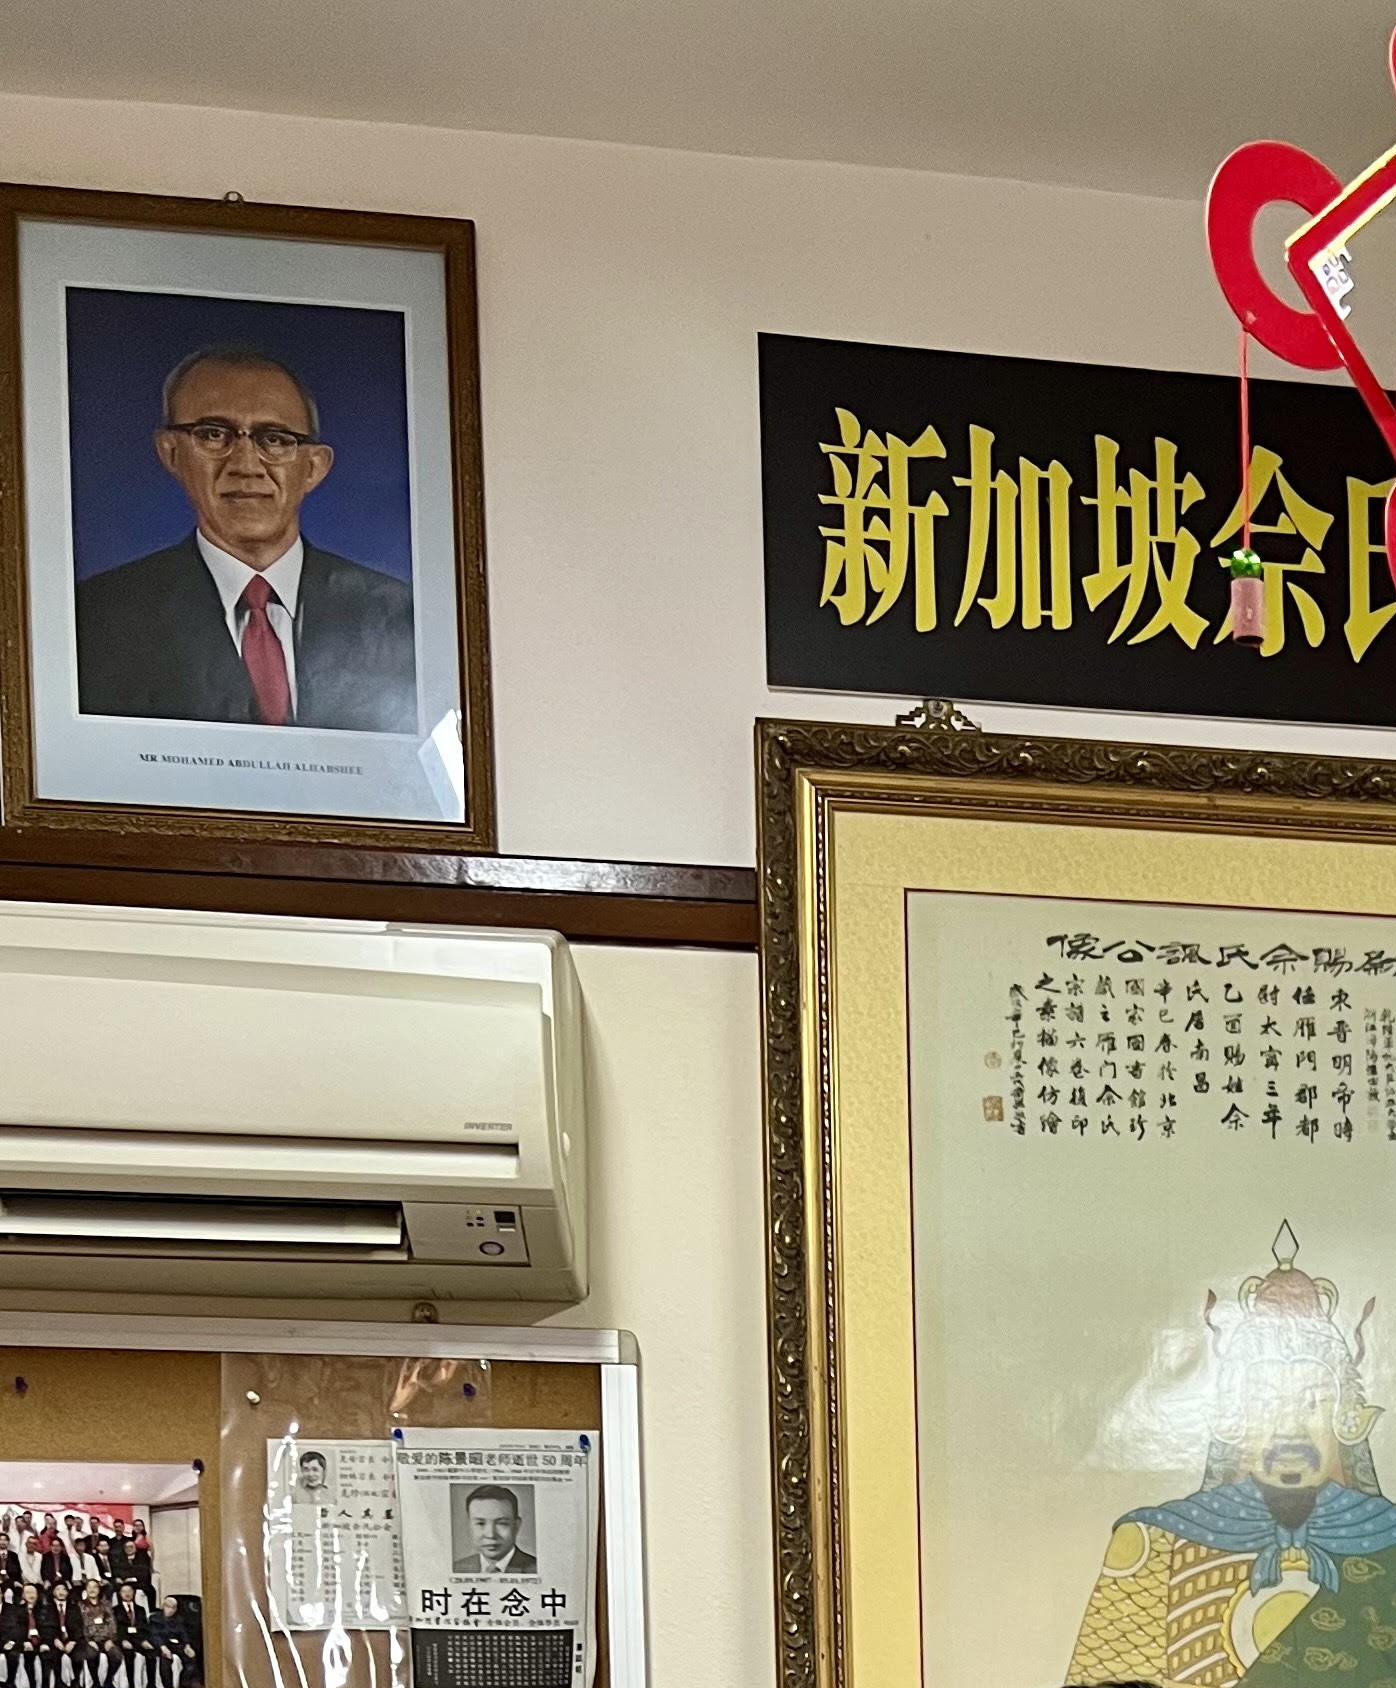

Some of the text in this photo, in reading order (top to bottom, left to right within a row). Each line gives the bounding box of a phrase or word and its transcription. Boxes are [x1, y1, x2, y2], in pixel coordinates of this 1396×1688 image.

[139, 753, 158, 762] MR
[161, 754, 225, 767] MOHAMED
[227, 759, 291, 771] ABDULLAH
[421, 1587, 567, 1618] 时在念中
